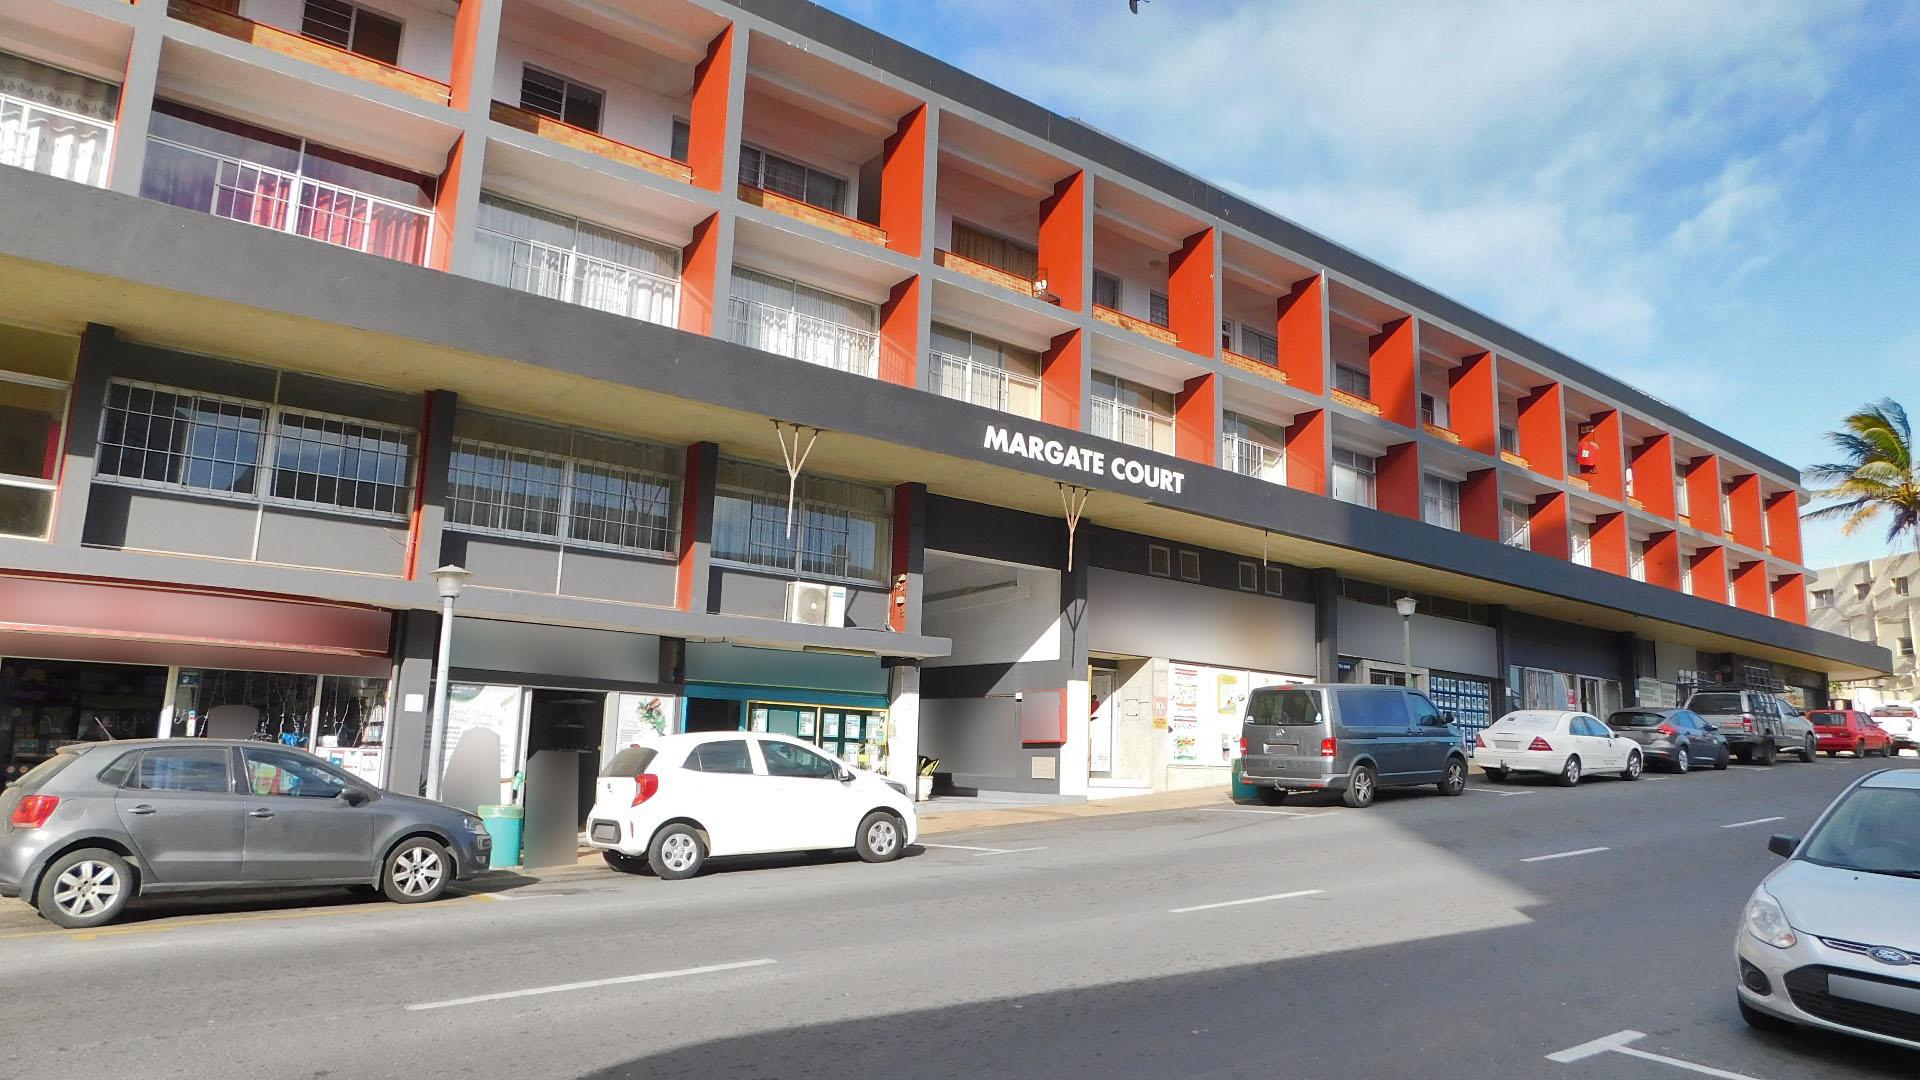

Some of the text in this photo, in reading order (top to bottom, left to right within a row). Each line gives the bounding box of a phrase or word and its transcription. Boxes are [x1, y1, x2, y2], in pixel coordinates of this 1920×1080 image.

[983, 425, 1185, 494] MARGATE COURT
[1876, 949, 1902, 961] Ford
